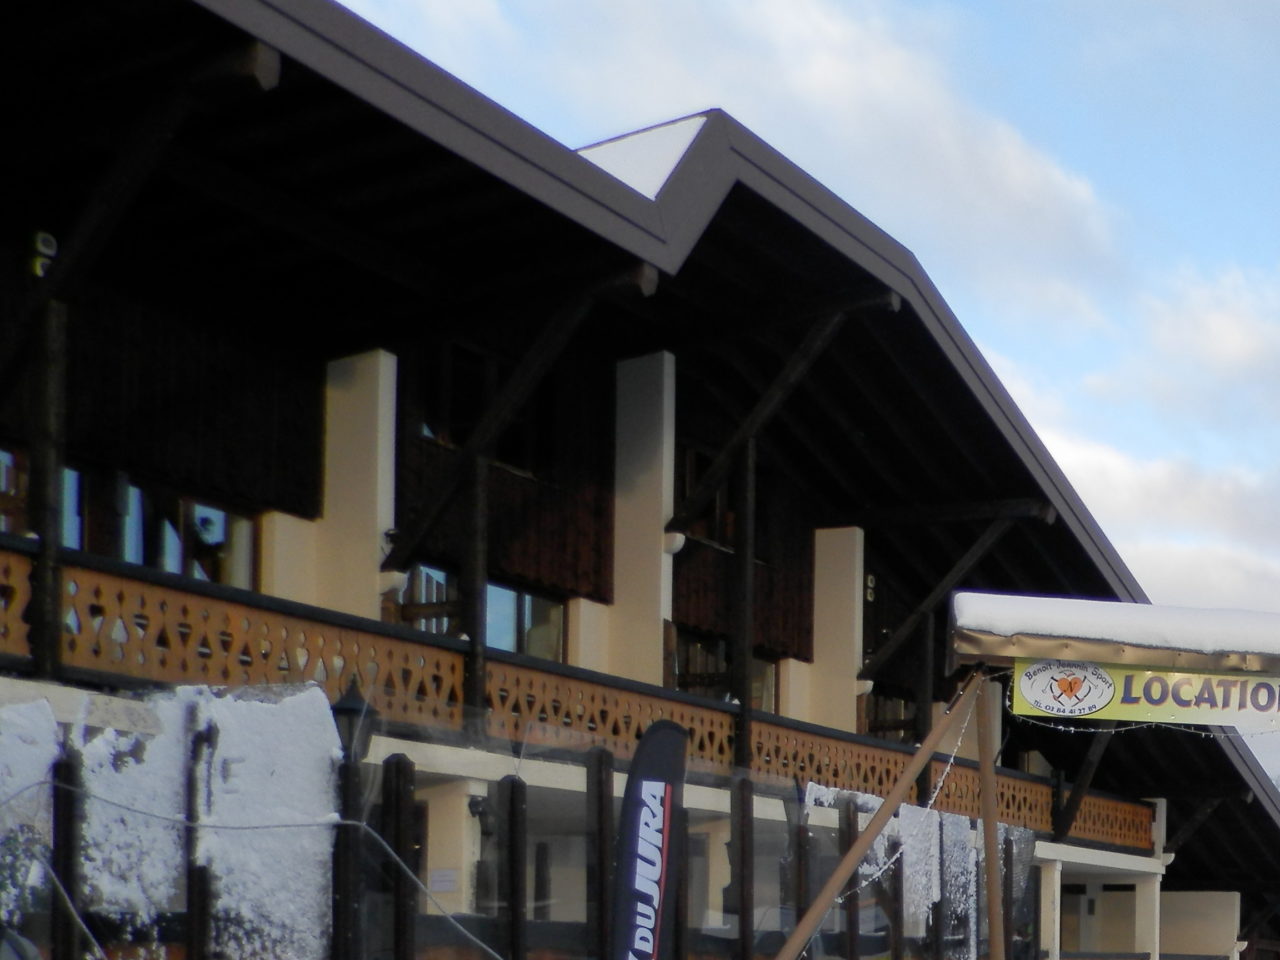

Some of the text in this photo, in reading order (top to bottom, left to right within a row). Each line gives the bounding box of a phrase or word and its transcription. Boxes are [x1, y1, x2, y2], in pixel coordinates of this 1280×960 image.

[1091, 666, 1112, 689] Sport
[635, 781, 666, 910] JURA
[633, 902, 656, 954] DU
